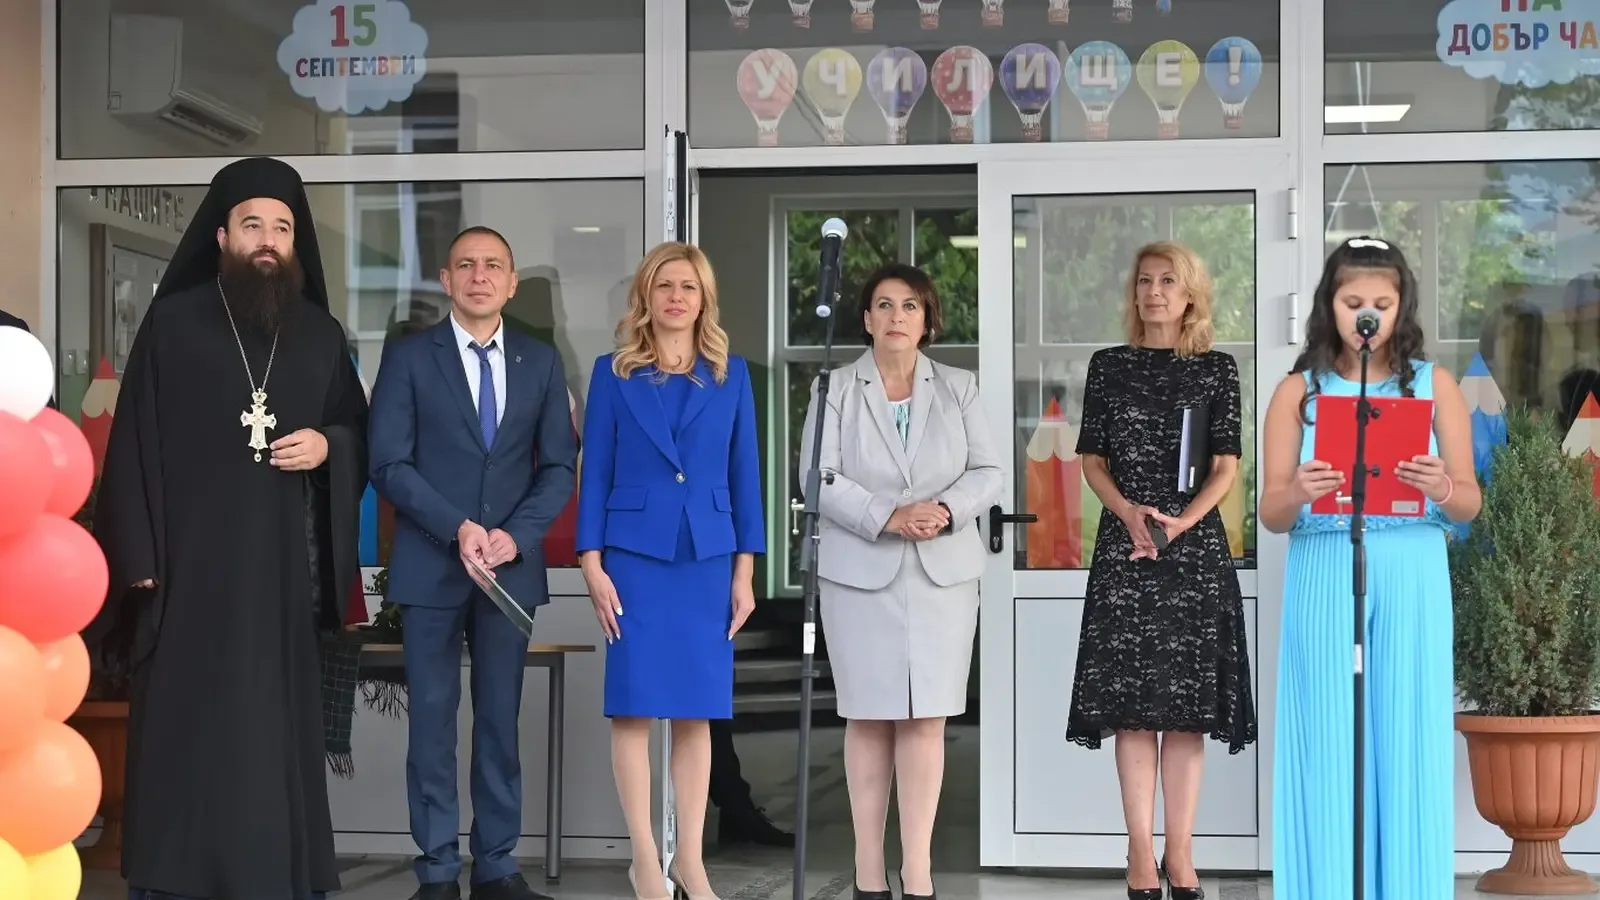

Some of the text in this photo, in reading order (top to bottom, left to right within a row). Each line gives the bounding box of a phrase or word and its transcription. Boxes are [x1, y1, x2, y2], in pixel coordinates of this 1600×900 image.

[330, 4, 377, 47] 15
[1447, 20, 1599, 56] ДОБЪР ЧА
[295, 54, 416, 78] СЕПТЕМВРИ
